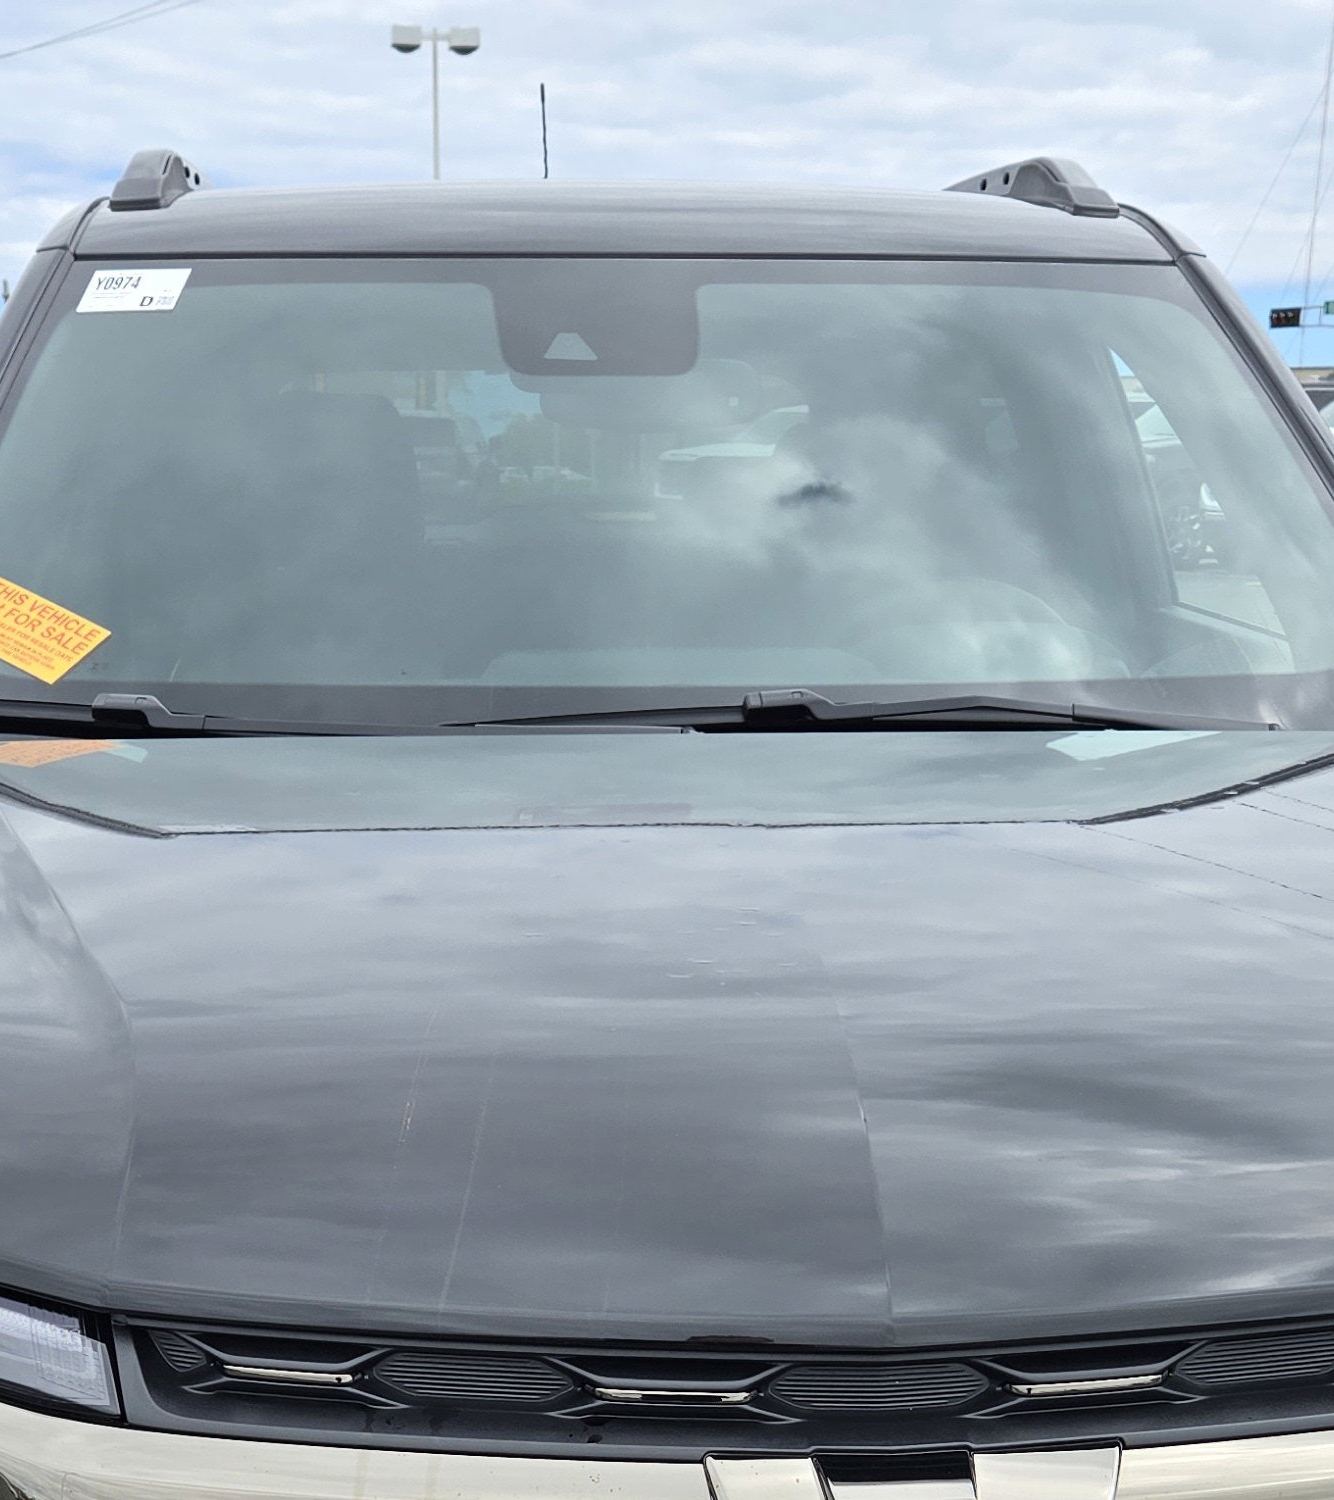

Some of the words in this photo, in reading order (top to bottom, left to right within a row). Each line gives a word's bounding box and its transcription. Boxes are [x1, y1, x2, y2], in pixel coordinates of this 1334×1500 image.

[95, 276, 142, 290] Y0974
[4, 607, 43, 632] FOR
[40, 626, 89, 655] SALE
[29, 600, 101, 642] VEHICLE
